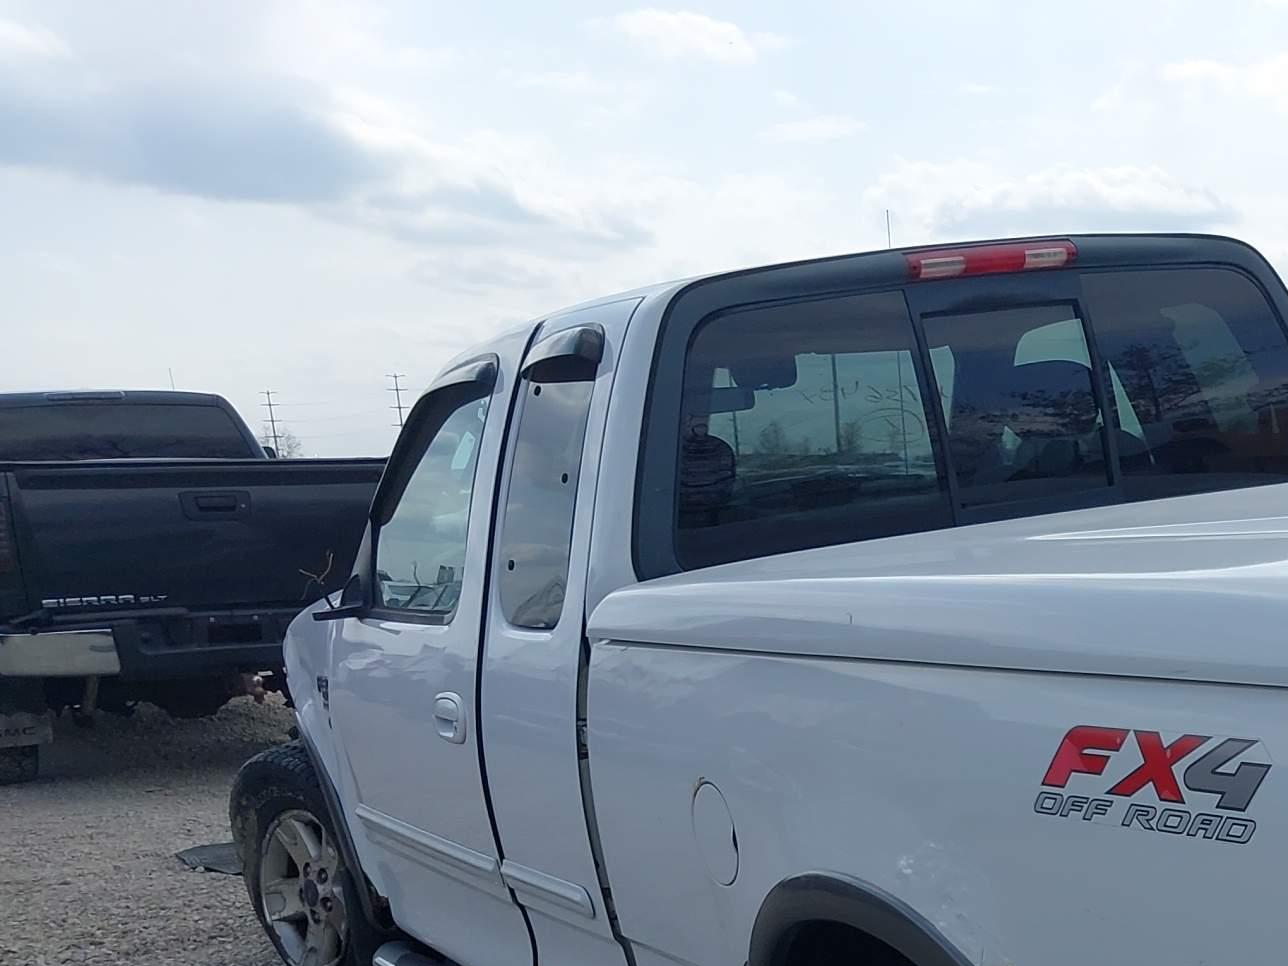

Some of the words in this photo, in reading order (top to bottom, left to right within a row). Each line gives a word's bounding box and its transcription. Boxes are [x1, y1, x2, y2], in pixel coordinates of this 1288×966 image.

[42, 594, 134, 608] SIERRA
[0, 727, 37, 737] MC
[1041, 725, 1272, 812] FX4
[1034, 792, 1114, 821] OFF
[1121, 803, 1257, 844] ROAD
